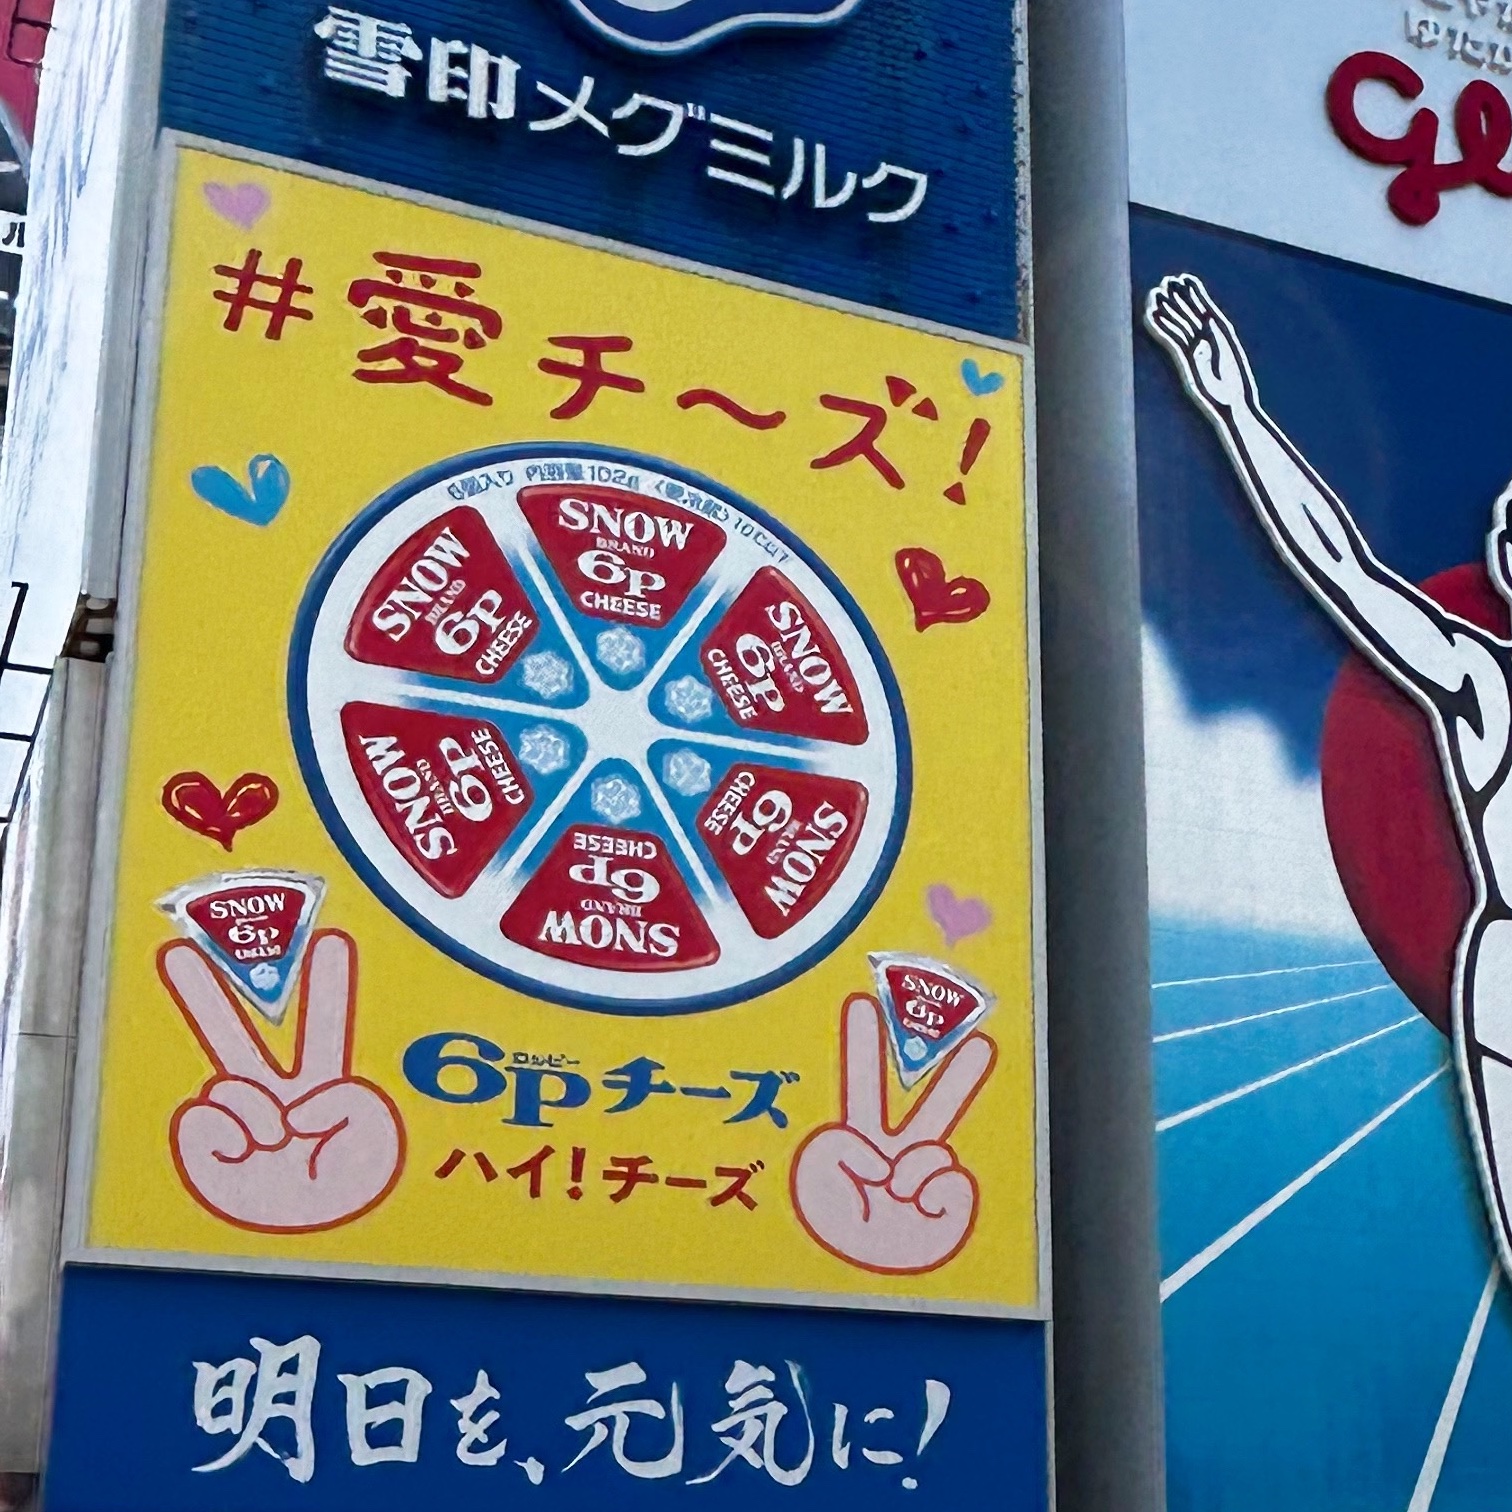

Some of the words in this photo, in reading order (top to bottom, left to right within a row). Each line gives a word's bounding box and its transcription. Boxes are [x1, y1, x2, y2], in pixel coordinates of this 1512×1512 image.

[313, 4, 930, 225] 雪印メグミルク
[558, 498, 695, 551] SNOW
[370, 527, 472, 642] SNOW
[579, 589, 664, 622] CHEESE
[473, 611, 534, 677] CHEESE
[764, 600, 854, 718] SNOW
[706, 647, 758, 721] CHEESE
[359, 733, 457, 862] SNOW
[472, 726, 527, 807] CHEESE
[703, 770, 757, 833] CHEESE
[572, 831, 659, 861] CHEESE
[762, 802, 849, 918] SNOW
[209, 892, 286, 920] SNOW
[538, 908, 682, 958] SNOW
[900, 974, 965, 1008] SNOW
